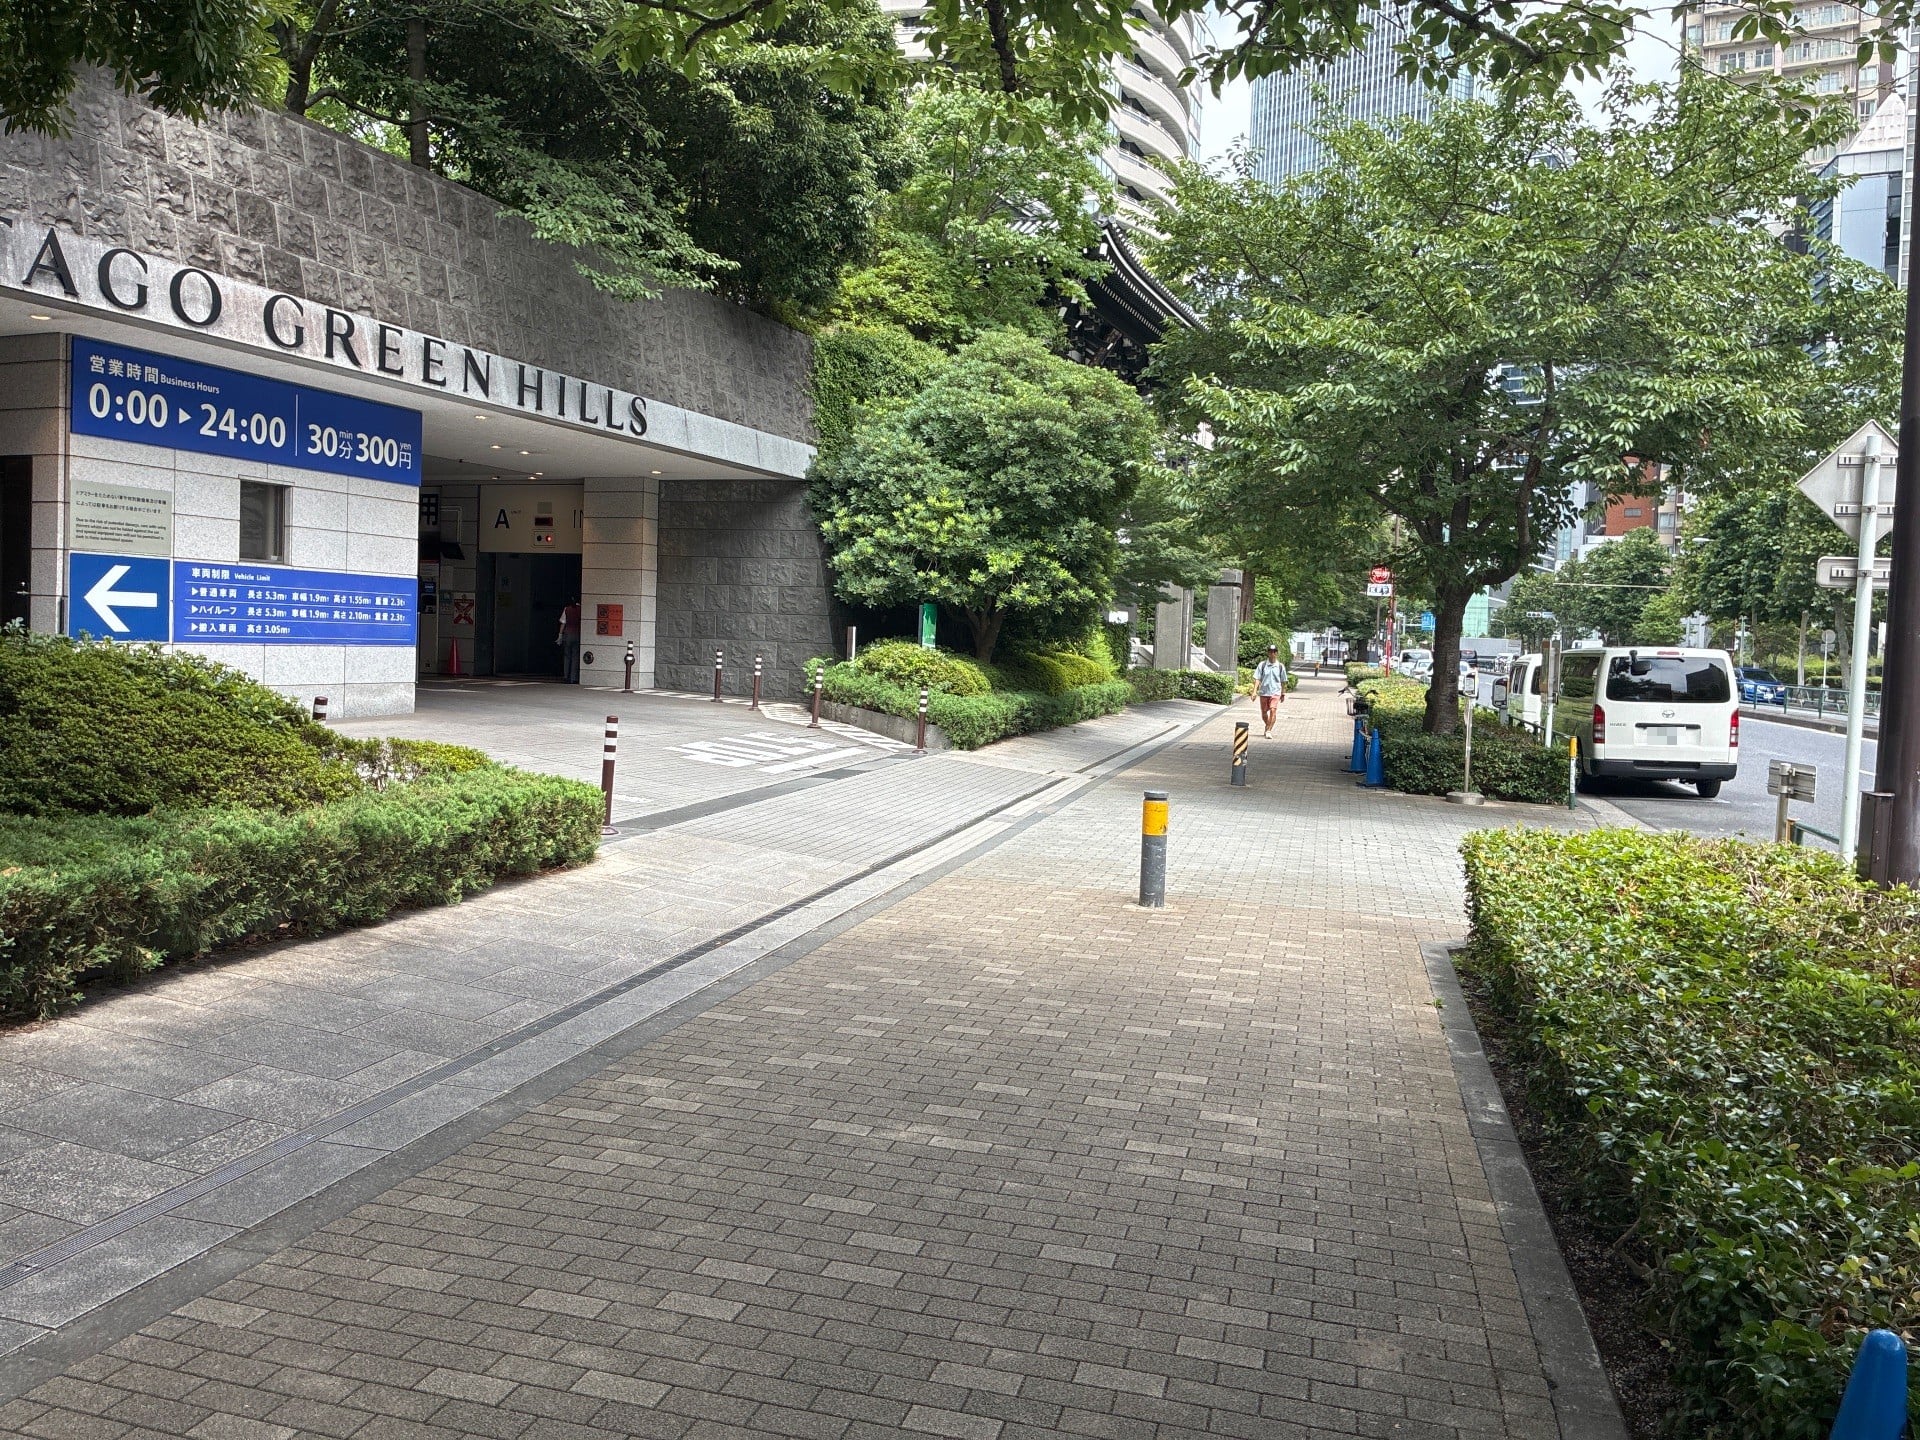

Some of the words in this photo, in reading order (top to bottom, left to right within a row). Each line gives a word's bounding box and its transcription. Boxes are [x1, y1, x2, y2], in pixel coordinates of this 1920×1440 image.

[0, 216, 223, 327] AGO
[263, 294, 491, 398] GREEN
[518, 364, 648, 436] HILLS
[90, 354, 159, 384] 営業時間
[160, 374, 195, 390] Business
[196, 381, 220, 394] Hours
[89, 383, 168, 428] 0:00
[200, 403, 286, 447] 24:00
[339, 430, 353, 440] min
[400, 442, 412, 451] yen
[494, 508, 510, 529] A
[191, 568, 230, 580] 車両制限
[234, 573, 255, 581] Vehicle
[199, 605, 237, 616] ハイルーフ
[664, 731, 838, 768] STOP
